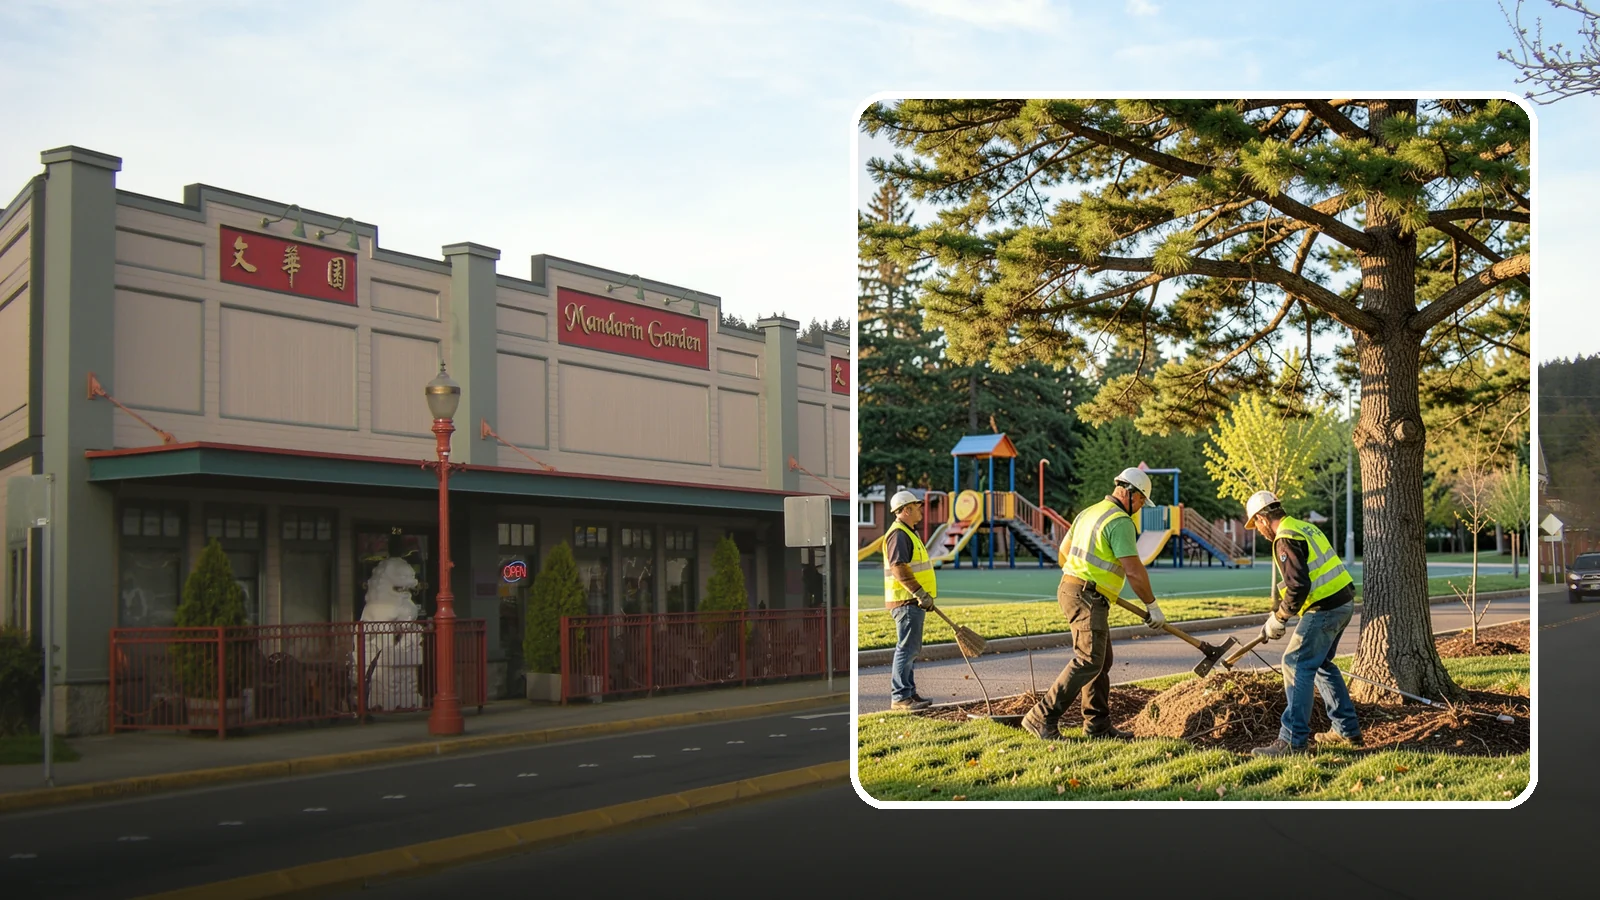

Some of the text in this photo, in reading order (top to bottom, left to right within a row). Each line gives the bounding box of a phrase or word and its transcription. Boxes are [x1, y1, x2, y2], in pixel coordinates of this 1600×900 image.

[231, 236, 346, 290] 文華園
[565, 303, 701, 351] Mandarin Garden
[503, 565, 527, 578] OPEN
